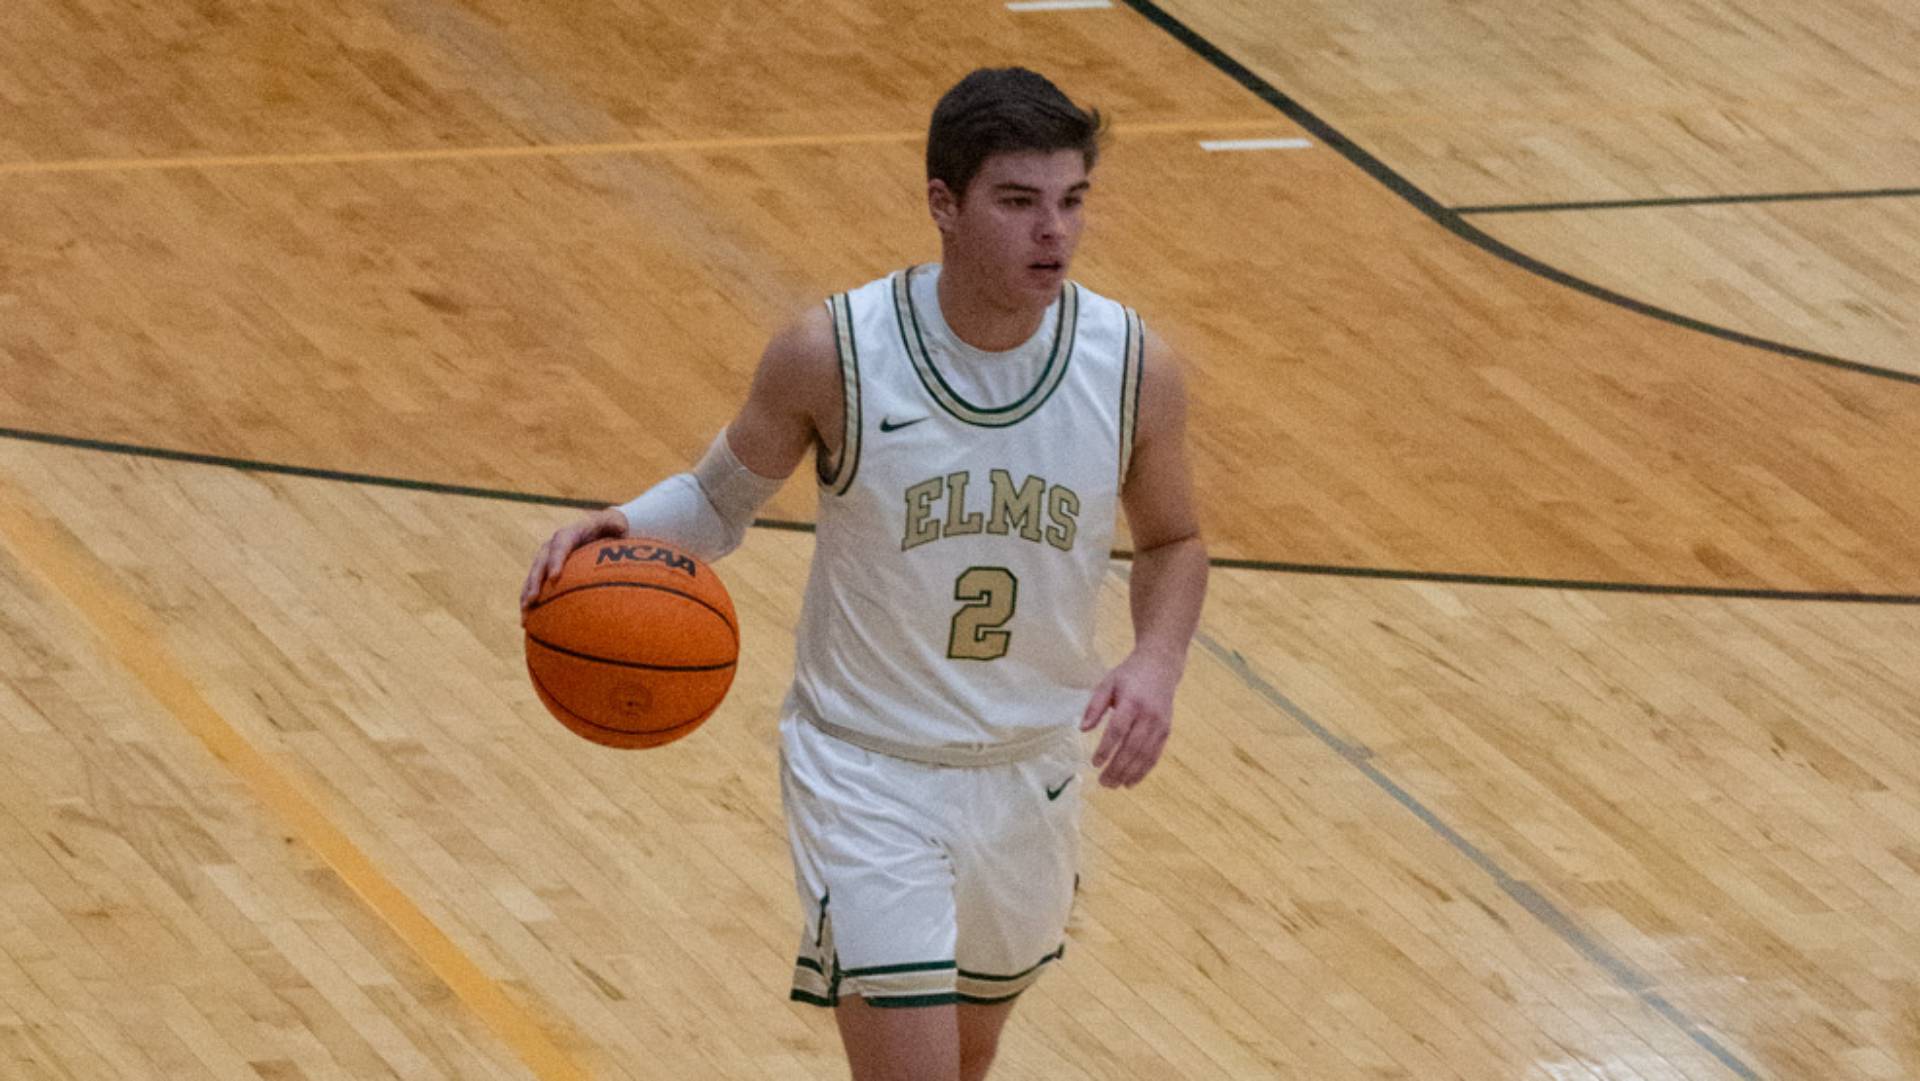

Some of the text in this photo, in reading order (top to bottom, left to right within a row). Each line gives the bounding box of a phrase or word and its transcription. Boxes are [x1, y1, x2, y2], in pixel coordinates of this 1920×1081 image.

[902, 469, 1080, 551] ELMS
[596, 545, 696, 577] NCAA
[947, 566, 1018, 661] 2
